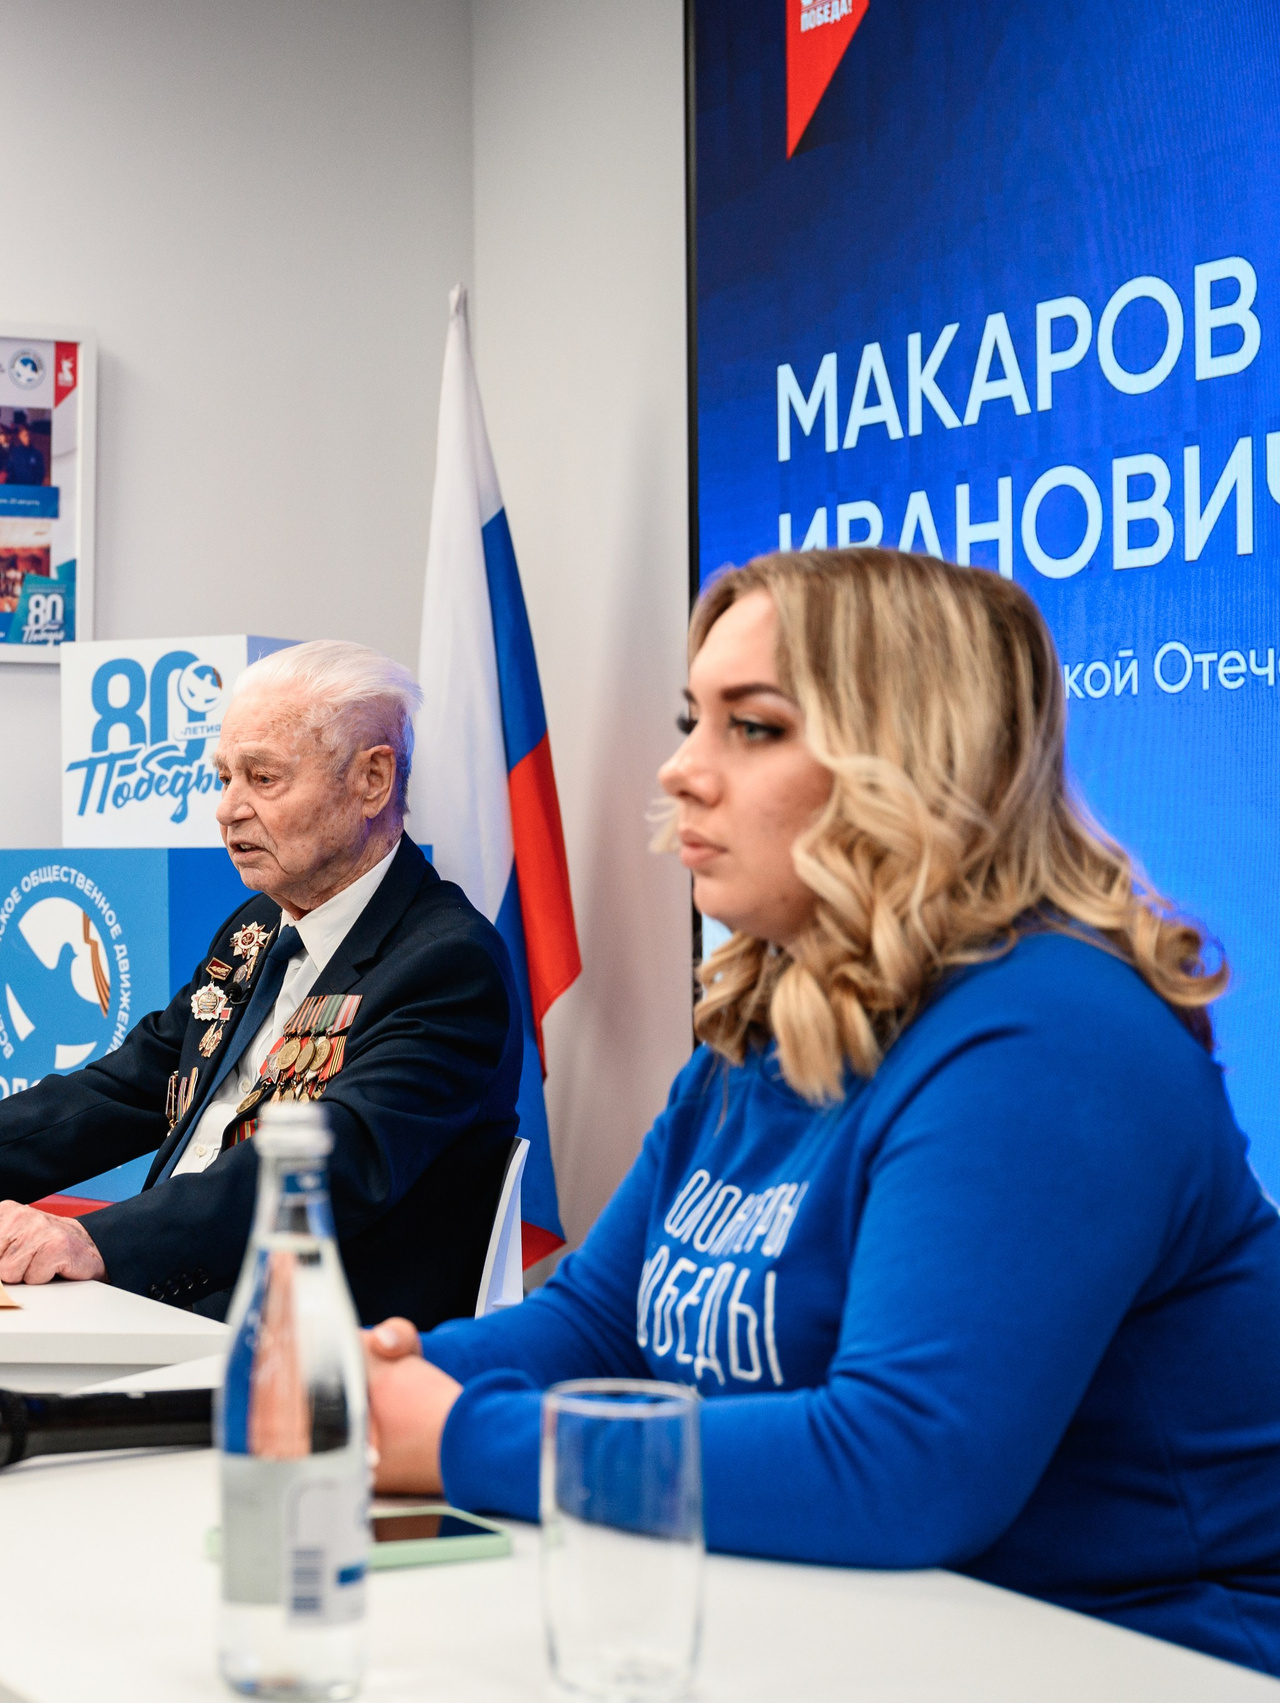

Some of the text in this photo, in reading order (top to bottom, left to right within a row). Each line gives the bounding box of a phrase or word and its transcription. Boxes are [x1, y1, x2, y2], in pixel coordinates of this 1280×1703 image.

[777, 256, 1261, 462] МАКАРОВ
[778, 431, 1280, 580] АНОВИ
[28, 593, 64, 626] 80
[1153, 641, 1280, 694] Отеч
[91, 650, 207, 765] 80
[21, 864, 122, 940] ОБЩЕСТВЕННОЕ
[106, 943, 131, 1055] ДВИЖЕНИ
[637, 1244, 783, 1386] ОБЕДЫ
